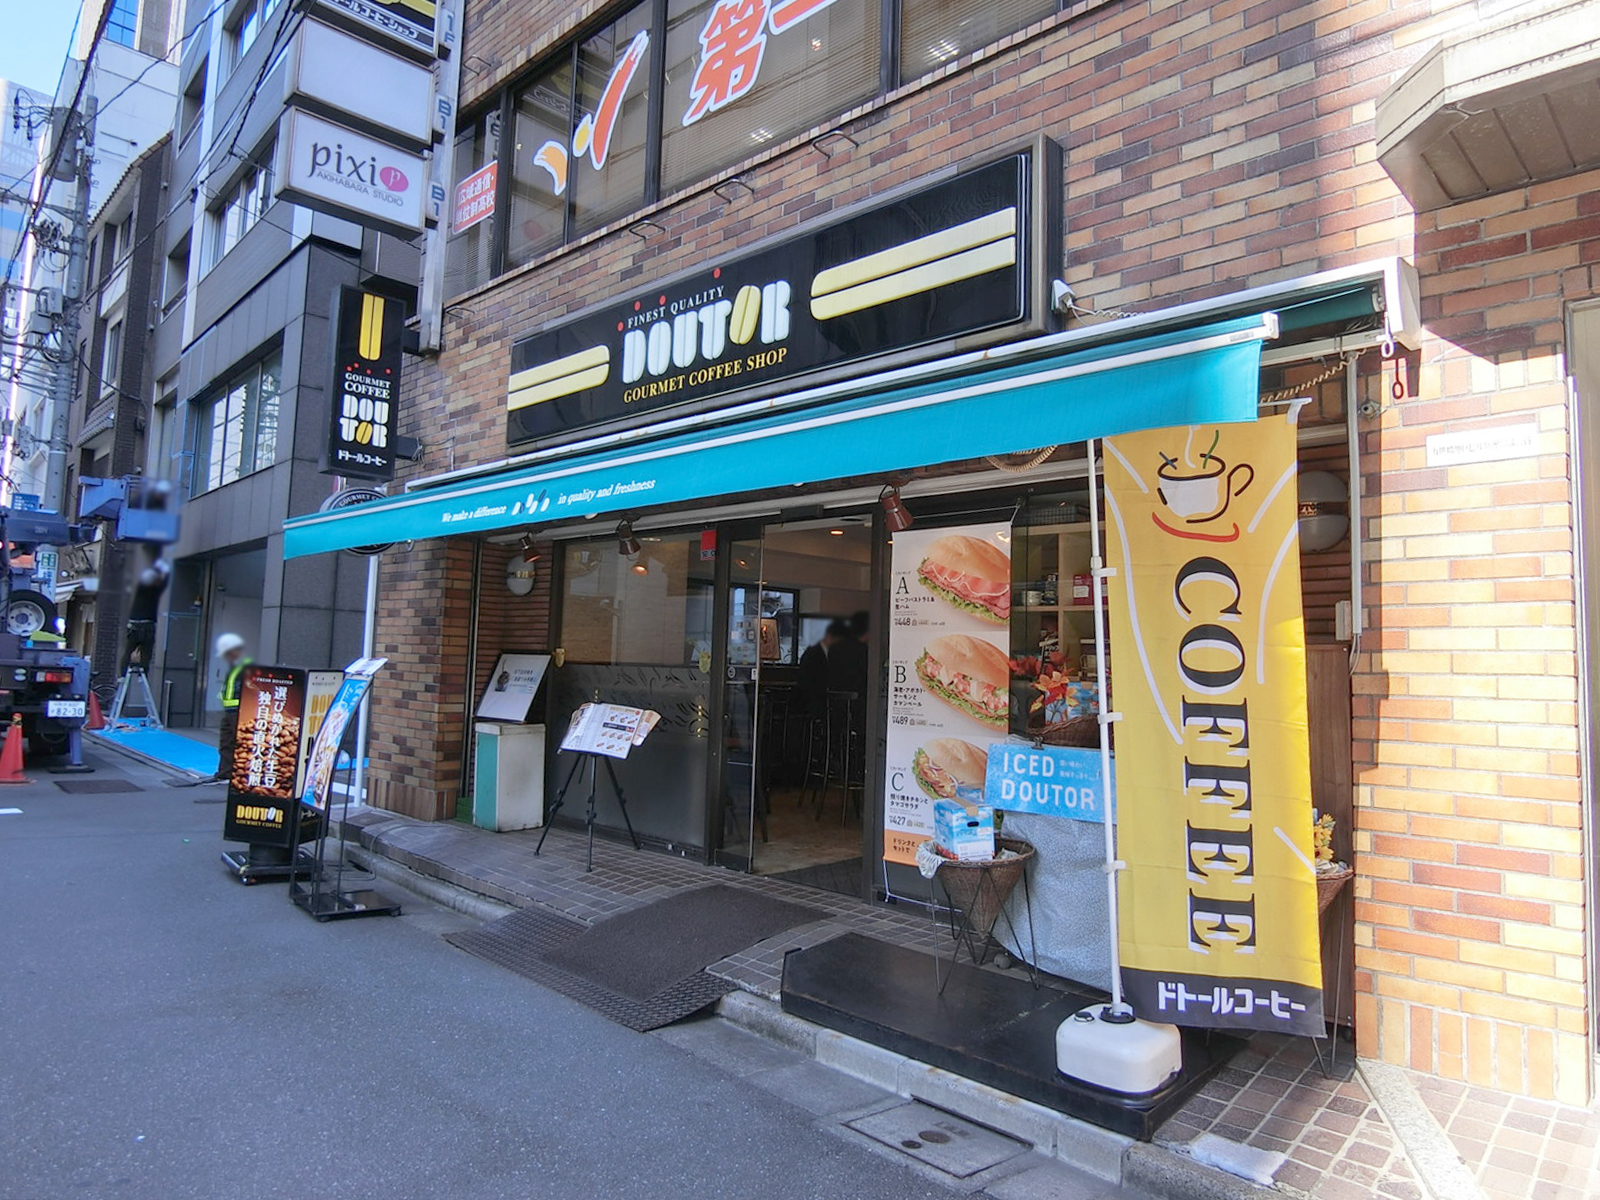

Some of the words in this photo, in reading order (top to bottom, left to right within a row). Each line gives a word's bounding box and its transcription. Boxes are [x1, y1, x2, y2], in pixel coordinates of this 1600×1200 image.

[307, 142, 378, 187] pixi
[316, 170, 370, 196] AKIHABARA
[372, 189, 404, 207] STUDIO
[627, 306, 667, 329] FINEST
[670, 285, 725, 314] QUALITY
[622, 279, 791, 384] DOUTOR
[344, 372, 392, 390] GOURMET
[623, 375, 686, 404] GOURMET
[688, 360, 743, 387] COFFEE
[746, 347, 788, 372] SHOP
[343, 381, 391, 400] COFFEE
[337, 449, 388, 467] ドトールコーヒー
[557, 493, 567, 504] in
[567, 488, 596, 506] quality
[596, 484, 613, 498] and
[613, 479, 657, 495] freshness
[474, 505, 507, 518] difference
[895, 576, 910, 595] A
[894, 665, 907, 684] B
[1003, 752, 1055, 778] ICED
[1173, 556, 1257, 955] COFFEE
[891, 772, 904, 792] C
[1001, 779, 1095, 811] DOUTOR
[236, 804, 284, 823] DOUTOR
[1158, 981, 1306, 1019] ドトールコーヒー
